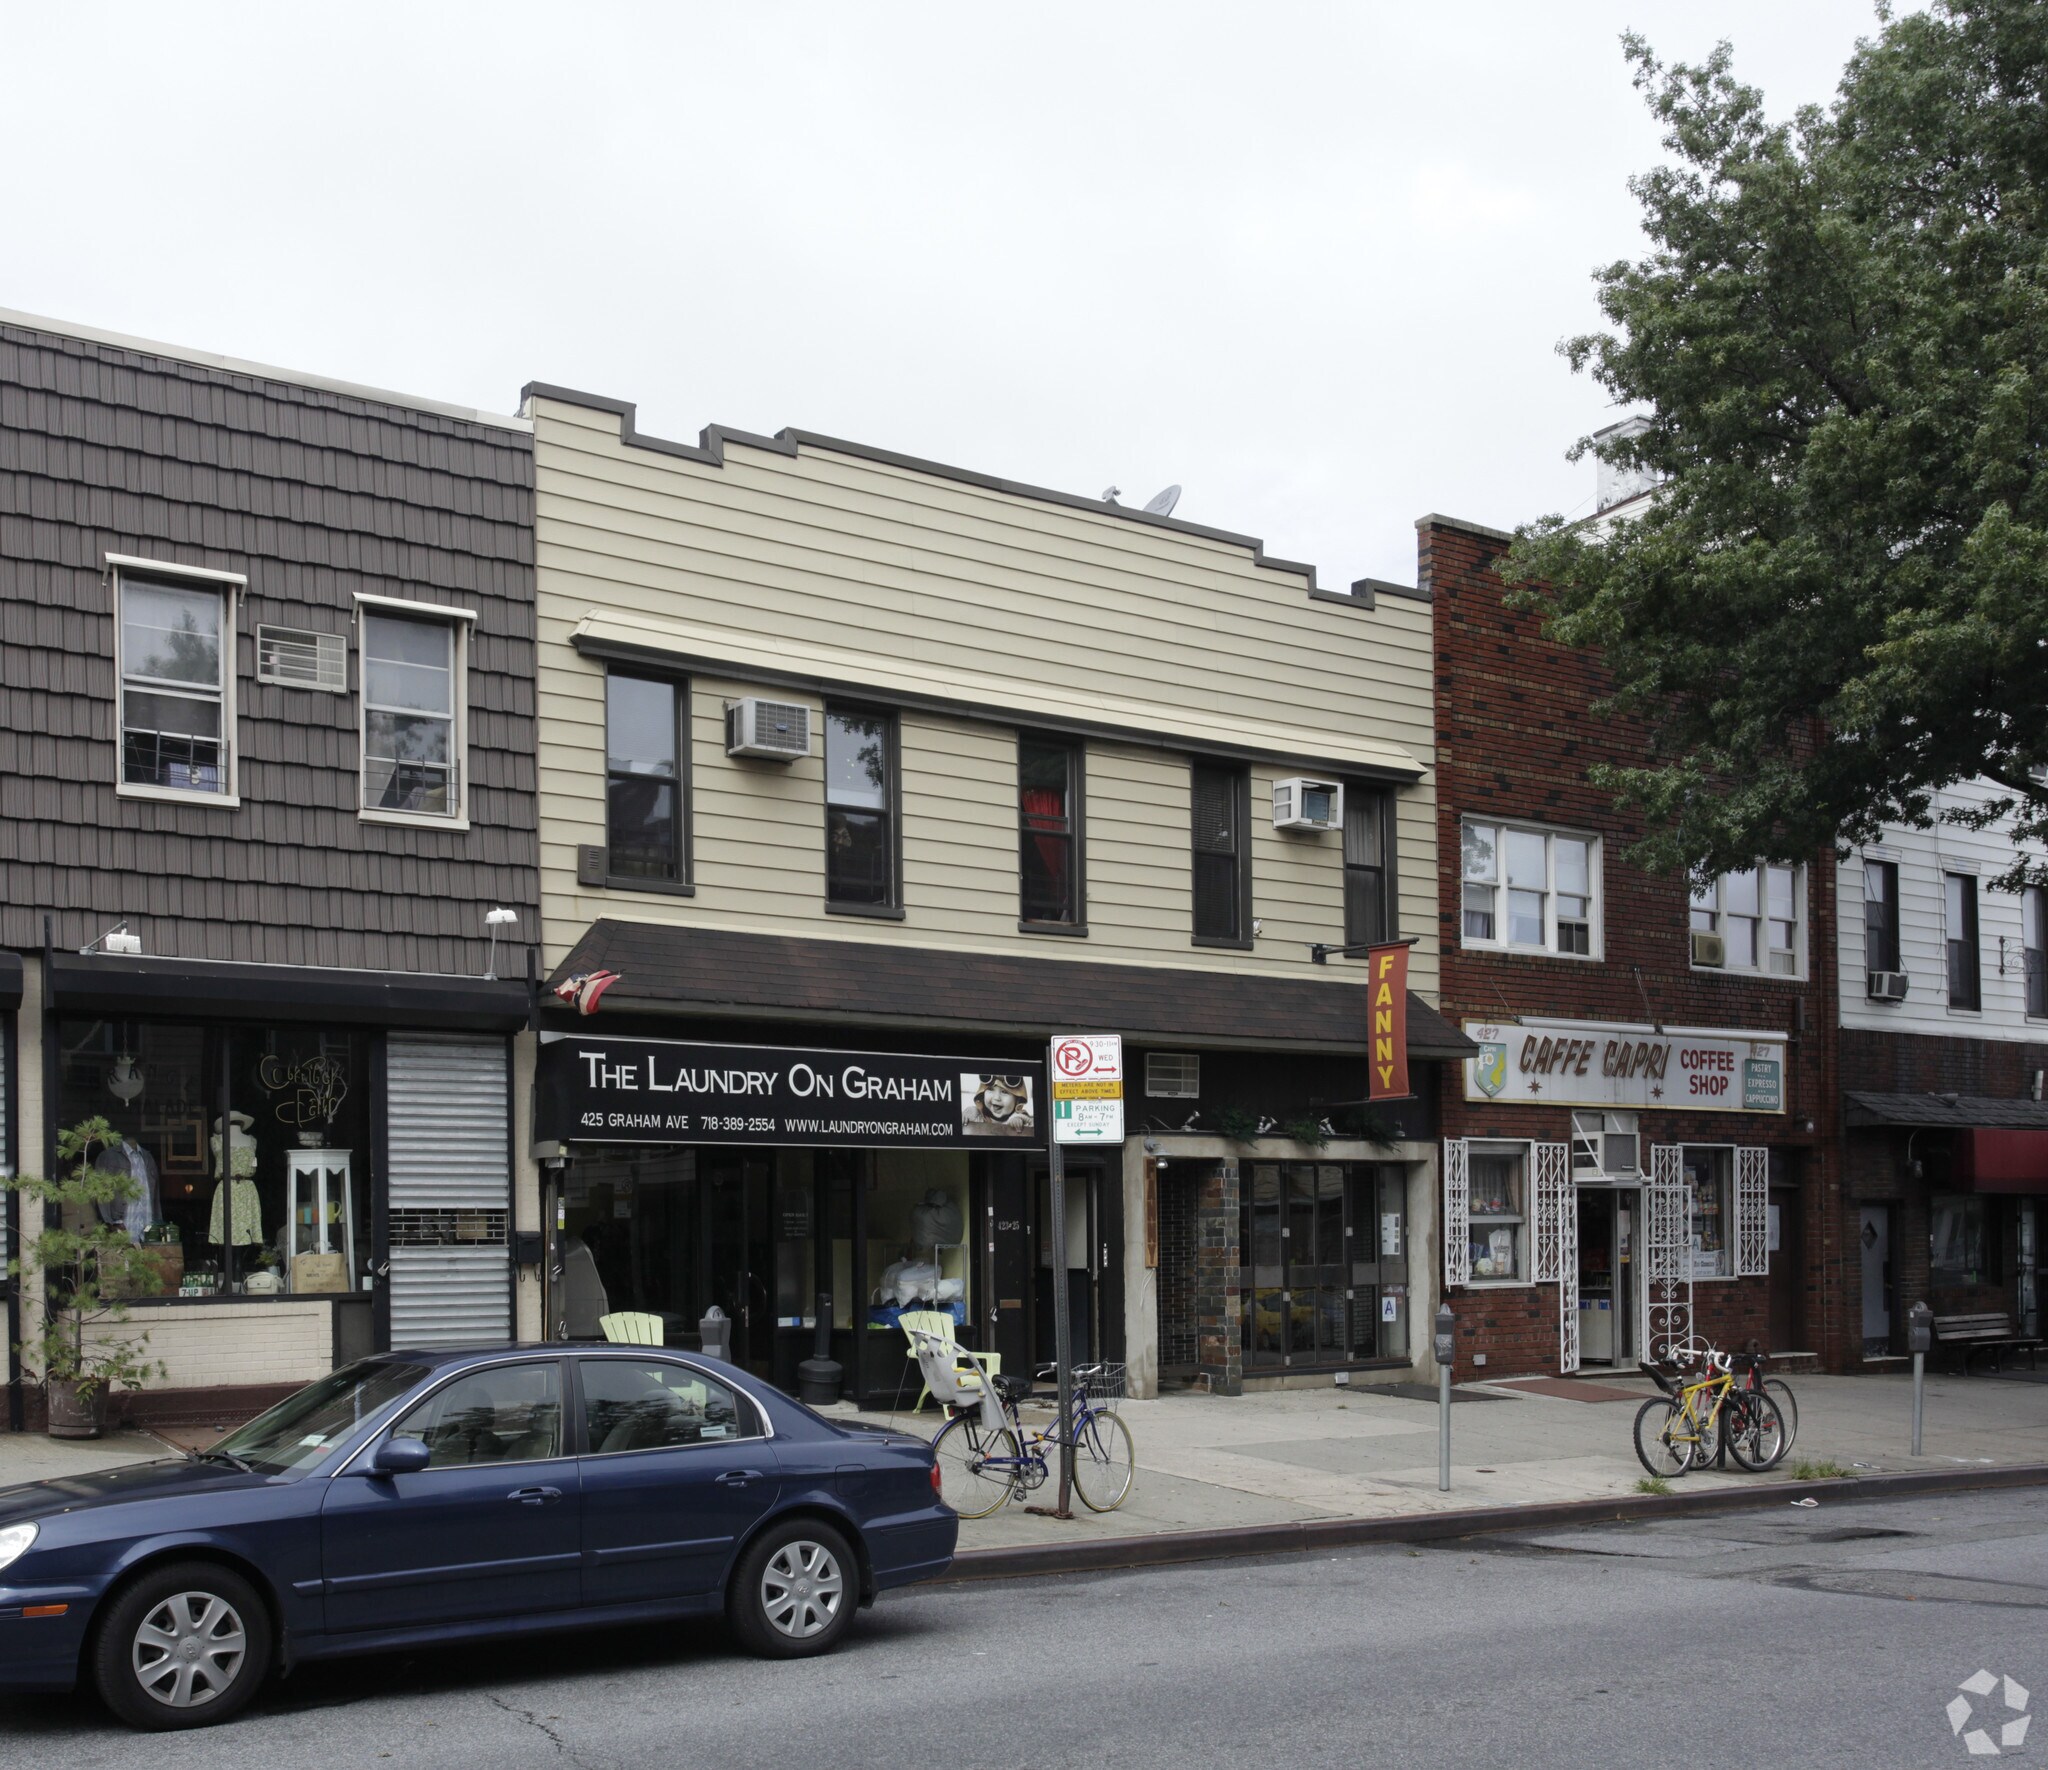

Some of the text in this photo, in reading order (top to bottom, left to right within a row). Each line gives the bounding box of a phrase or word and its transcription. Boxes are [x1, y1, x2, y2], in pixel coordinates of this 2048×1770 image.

[1375, 955, 1394, 1089] FANNY
[1477, 1028, 1499, 1040] 427
[1098, 1054, 1113, 1062] WED
[1519, 1034, 1671, 1080] CAFFE CAPRI
[1752, 1045, 1770, 1058] 27
[1680, 1049, 1735, 1072] COFFEE
[1751, 1062, 1772, 1073] PASTRY
[579, 1050, 952, 1102] THE LAUNDRY ON GRAHAM
[1689, 1074, 1729, 1096] SHOP
[1747, 1078, 1777, 1089] EXPRESSO
[1745, 1094, 1779, 1104] CAPPUCCINO
[1060, 1100, 1066, 1118] 1
[1075, 1104, 1115, 1112] PARKING
[580, 1112, 953, 1136] 425 GRAHAM AVE 718-389-2554 WWW.LAUNDRYONGRAHAM.COM
[181, 1288, 199, 1297] 7-UP
[1384, 1300, 1394, 1315] A
